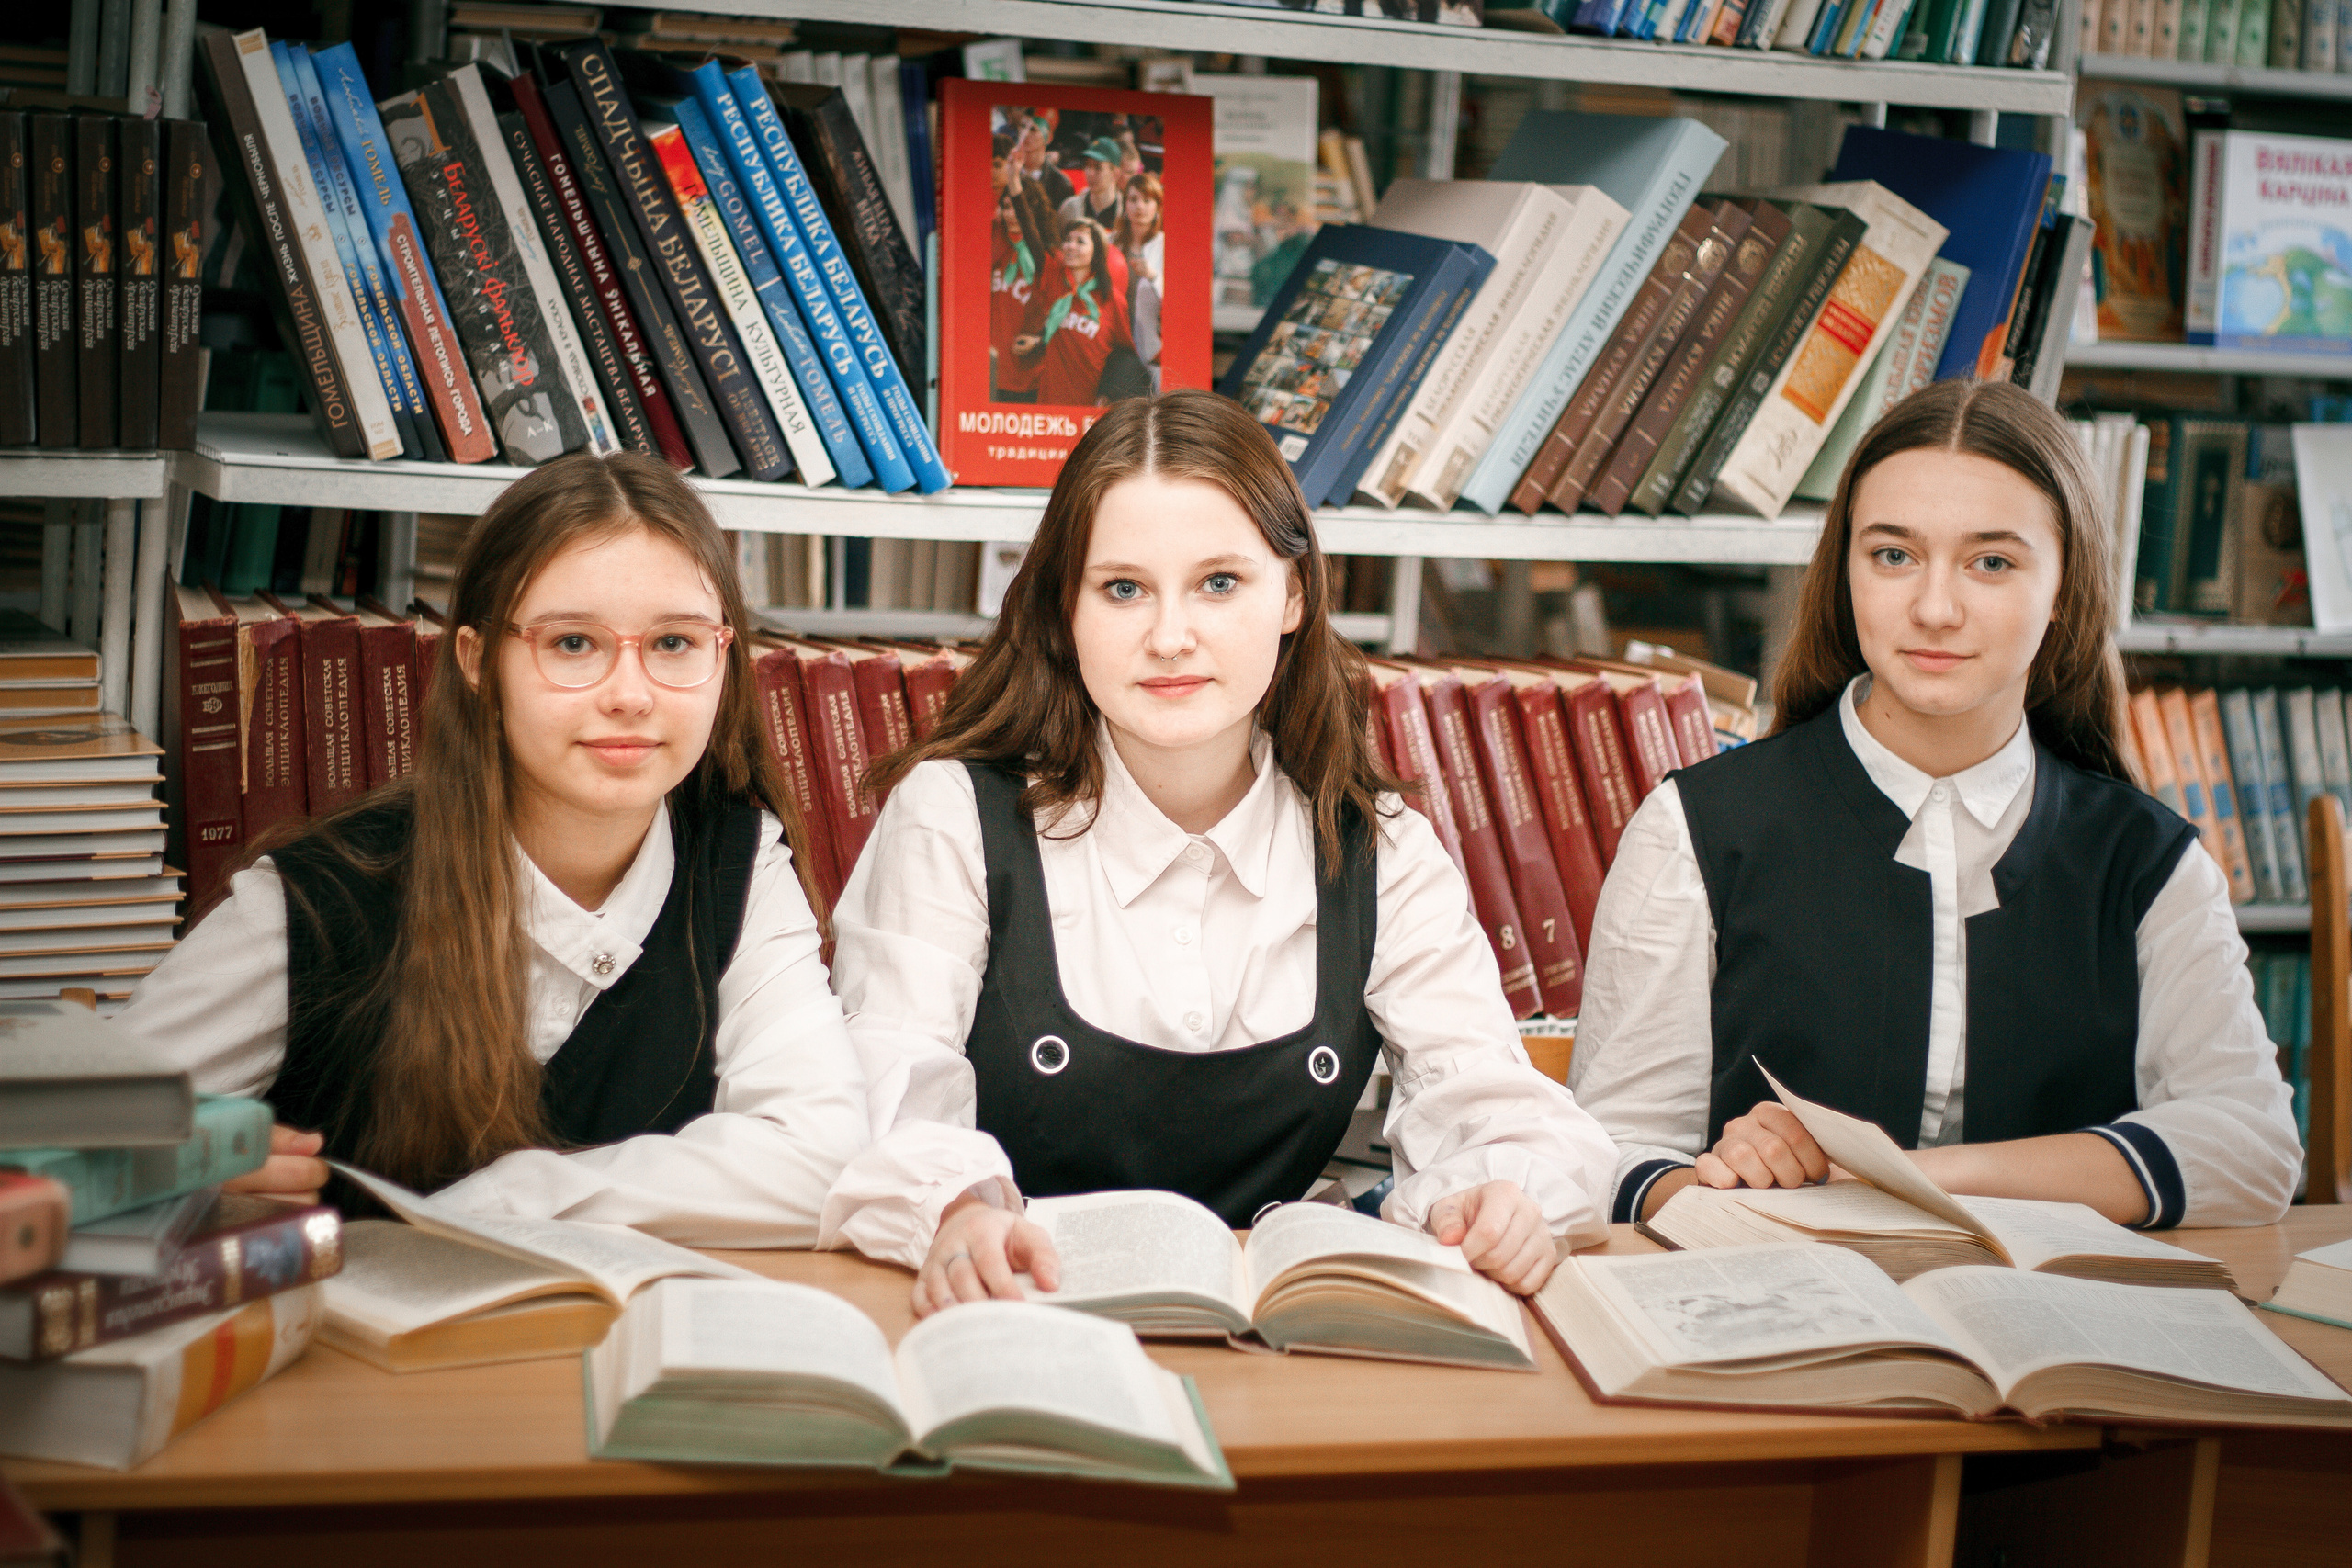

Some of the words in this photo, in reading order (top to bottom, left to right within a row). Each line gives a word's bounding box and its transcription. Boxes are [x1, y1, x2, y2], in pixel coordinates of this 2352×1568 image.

[243, 133, 271, 199] ЧЕРНОБЫЛЯ
[310, 153, 335, 214] РЕСУРСЫ
[330, 155, 356, 217] РЕСУРСЫ
[361, 140, 393, 206] ГОМЕЛЬ
[266, 201, 285, 241] ПОСЛЕ
[549, 152, 610, 284] ГОМЕЛЬШЧЫНА
[582, 53, 670, 234] СПАДЧЫНА
[657, 234, 741, 382] БЕЛАРУСІ
[717, 92, 797, 253] РЕСПУБЛИКА
[787, 251, 854, 376] БЕЛАРУСЬ
[718, 181, 766, 265] GOMEL
[749, 96, 832, 256] РЕСПУБЛИКА
[821, 255, 888, 378] БЕЛАРУСЬ
[1594, 172, 1692, 333] ГЕОГРАФИЧЕСКИЙ
[279, 243, 299, 284] ЖИЗНЬ
[514, 130, 551, 211] СУЧАСНАЕ
[546, 212, 586, 293] НАРОДНАЕ
[579, 296, 622, 387] МАСТАЦТВА
[616, 387, 651, 457] БЕЛАРУСІ
[346, 263, 381, 348] ГОМЕЛЬСКОЙ
[377, 353, 403, 412] ОБЛАСТИ
[367, 265, 402, 350] ГОМЕЛЬСКОЙ
[397, 355, 424, 414] ОБЛАСТИ
[396, 234, 435, 325] СТРОИТЕЛЬНАЯ
[427, 321, 455, 389] ЛЕТОПИСЬ
[449, 389, 473, 436] ГОРОДА
[684, 183, 749, 311] ГОМЕЛЬЩИНА
[745, 321, 806, 434] КУЛЬТУРНАЯ
[1664, 291, 1695, 342] ЯНКА
[1702, 291, 1735, 340] ЯНКА
[290, 284, 348, 429] ГОМЕЛЬЩИНА
[663, 323, 689, 370] ГОМЕЛЬ
[1563, 333, 1596, 385] АТЛАС
[1621, 345, 1666, 415] КУПАЛА
[1658, 342, 1705, 413] КУПАЛА
[738, 387, 781, 468] HERITAGE
[798, 356, 848, 444] ГОМЕЛЬ
[849, 395, 877, 446] ПРОГРЕССА
[855, 382, 873, 412] ГОДЫ
[866, 407, 896, 461] СОЗИДАНИЯ
[885, 398, 914, 448] ПРОГРЕССА
[891, 384, 910, 413] ГОДЫ
[903, 410, 933, 464] СОЗИДАНИЯ
[959, 411, 1078, 438] МОЛОДЕЖЬ
[1511, 386, 1566, 468] УЧИТЕЛЯ
[266, 657, 274, 727] СОВЕТСКАЯ
[279, 656, 290, 787] ЭНЦИКЛОПЕДИЯ
[323, 659, 334, 728] СОВЕТСКАЯ
[337, 657, 351, 789] ЭНЦИКЛОПЕДИЯ
[383, 666, 395, 735] СОВЕТСКАЯ
[396, 663, 412, 773] ЦИКЛОПЕДИЯ
[770, 690, 788, 757] СОВЕТСКАЯ
[828, 694, 846, 760] СОВЕТСКАЯ
[266, 731, 274, 788] БОЛЬШАЯ
[326, 733, 336, 789] БОЛЬШАЯ
[387, 740, 397, 780] ЛЬШАЯ
[781, 688, 812, 812] ЭНЦИКЛОПЕДИЯ
[841, 764, 858, 819] БОЛЬШАЯ
[1500, 924, 1516, 951] 8
[1543, 918, 1555, 944] 7
